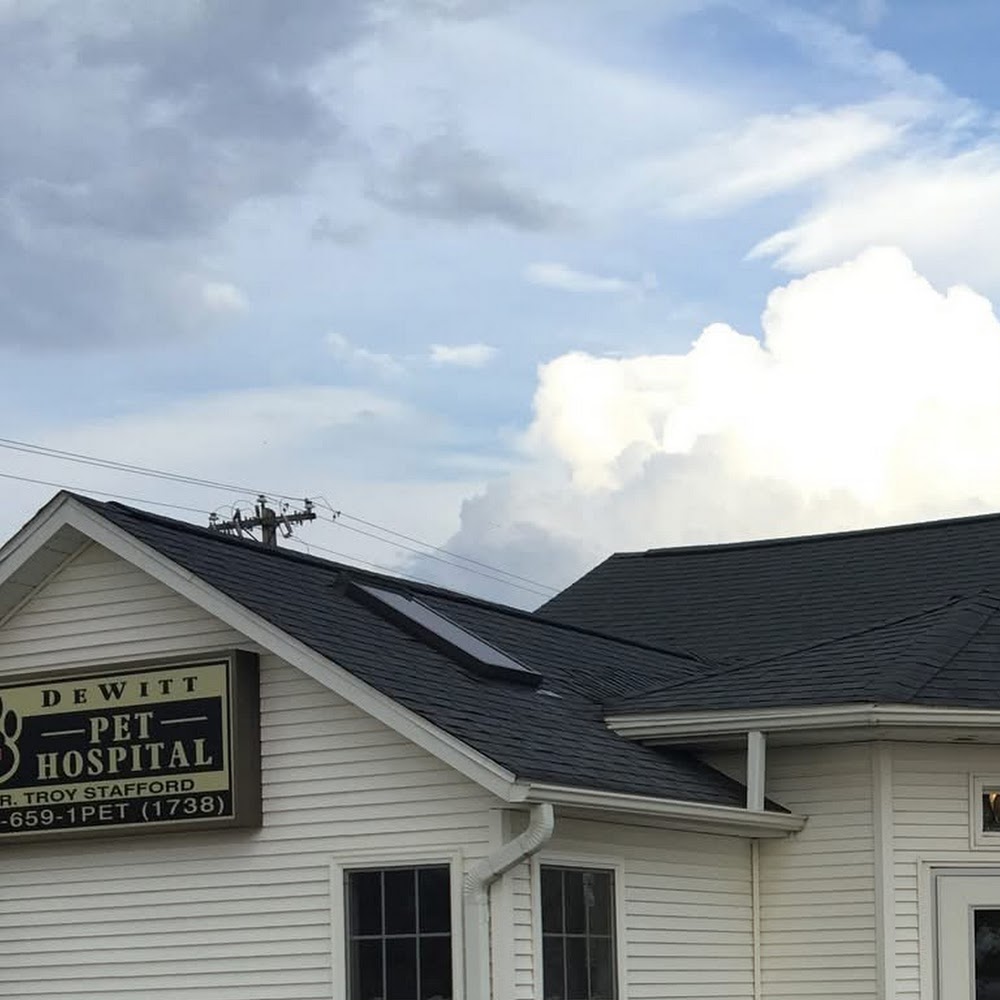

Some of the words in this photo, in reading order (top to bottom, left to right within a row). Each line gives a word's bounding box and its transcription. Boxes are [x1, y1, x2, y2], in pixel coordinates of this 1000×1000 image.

[41, 676, 198, 708] DEWITT
[89, 711, 154, 744] PET
[36, 738, 213, 780] HOSPITAL
[23, 787, 78, 804] TROY
[83, 778, 195, 799] STAFFORD
[141, 795, 225, 821] (1738)
